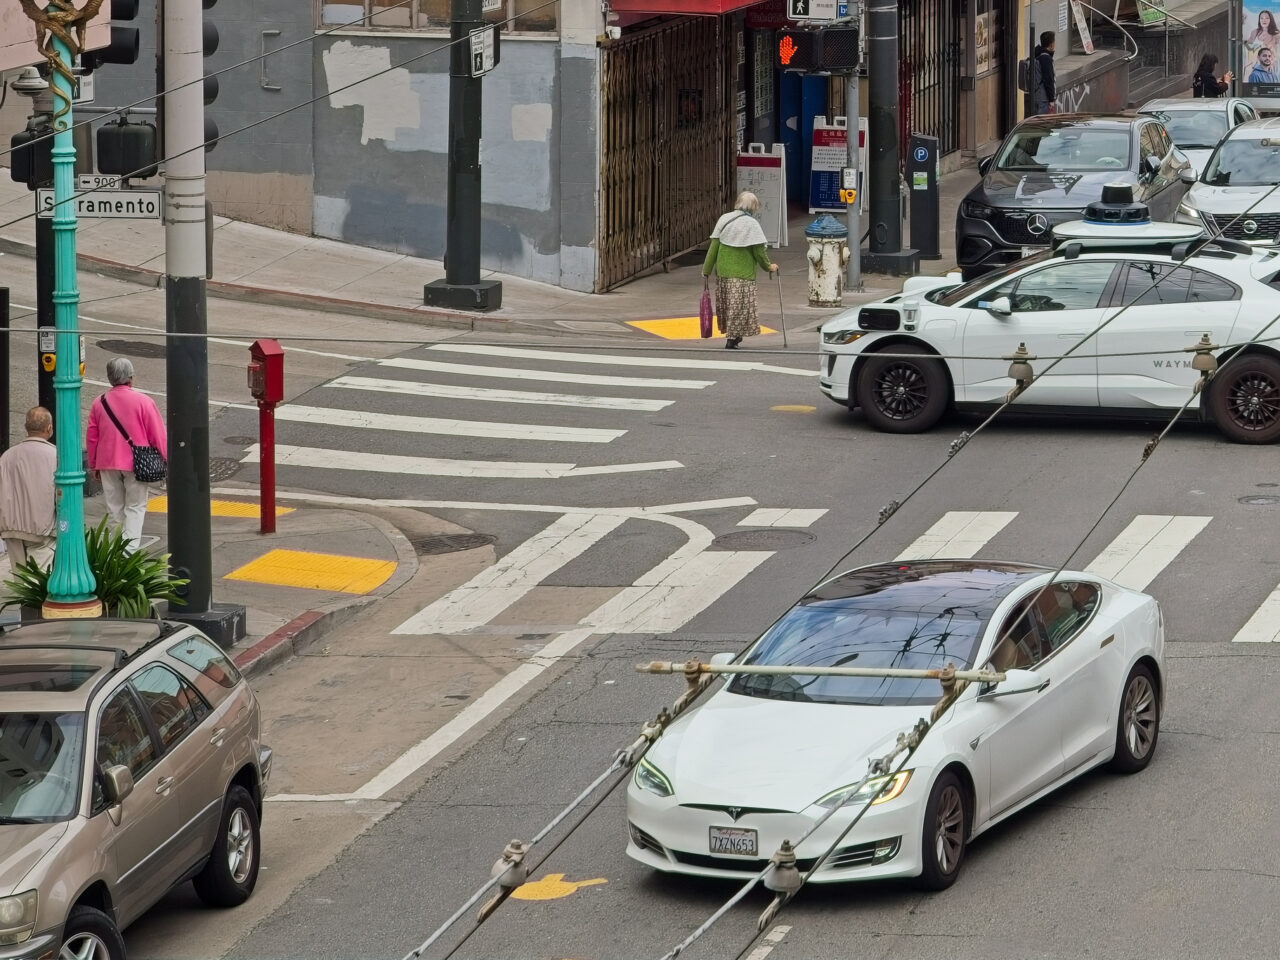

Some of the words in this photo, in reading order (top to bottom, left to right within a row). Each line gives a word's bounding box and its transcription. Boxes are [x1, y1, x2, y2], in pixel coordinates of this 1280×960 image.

[93, 177, 116, 188] 900
[43, 196, 156, 214] Sramento
[1153, 359, 1193, 368] WAYM
[712, 836, 754, 852] 7XZN653
